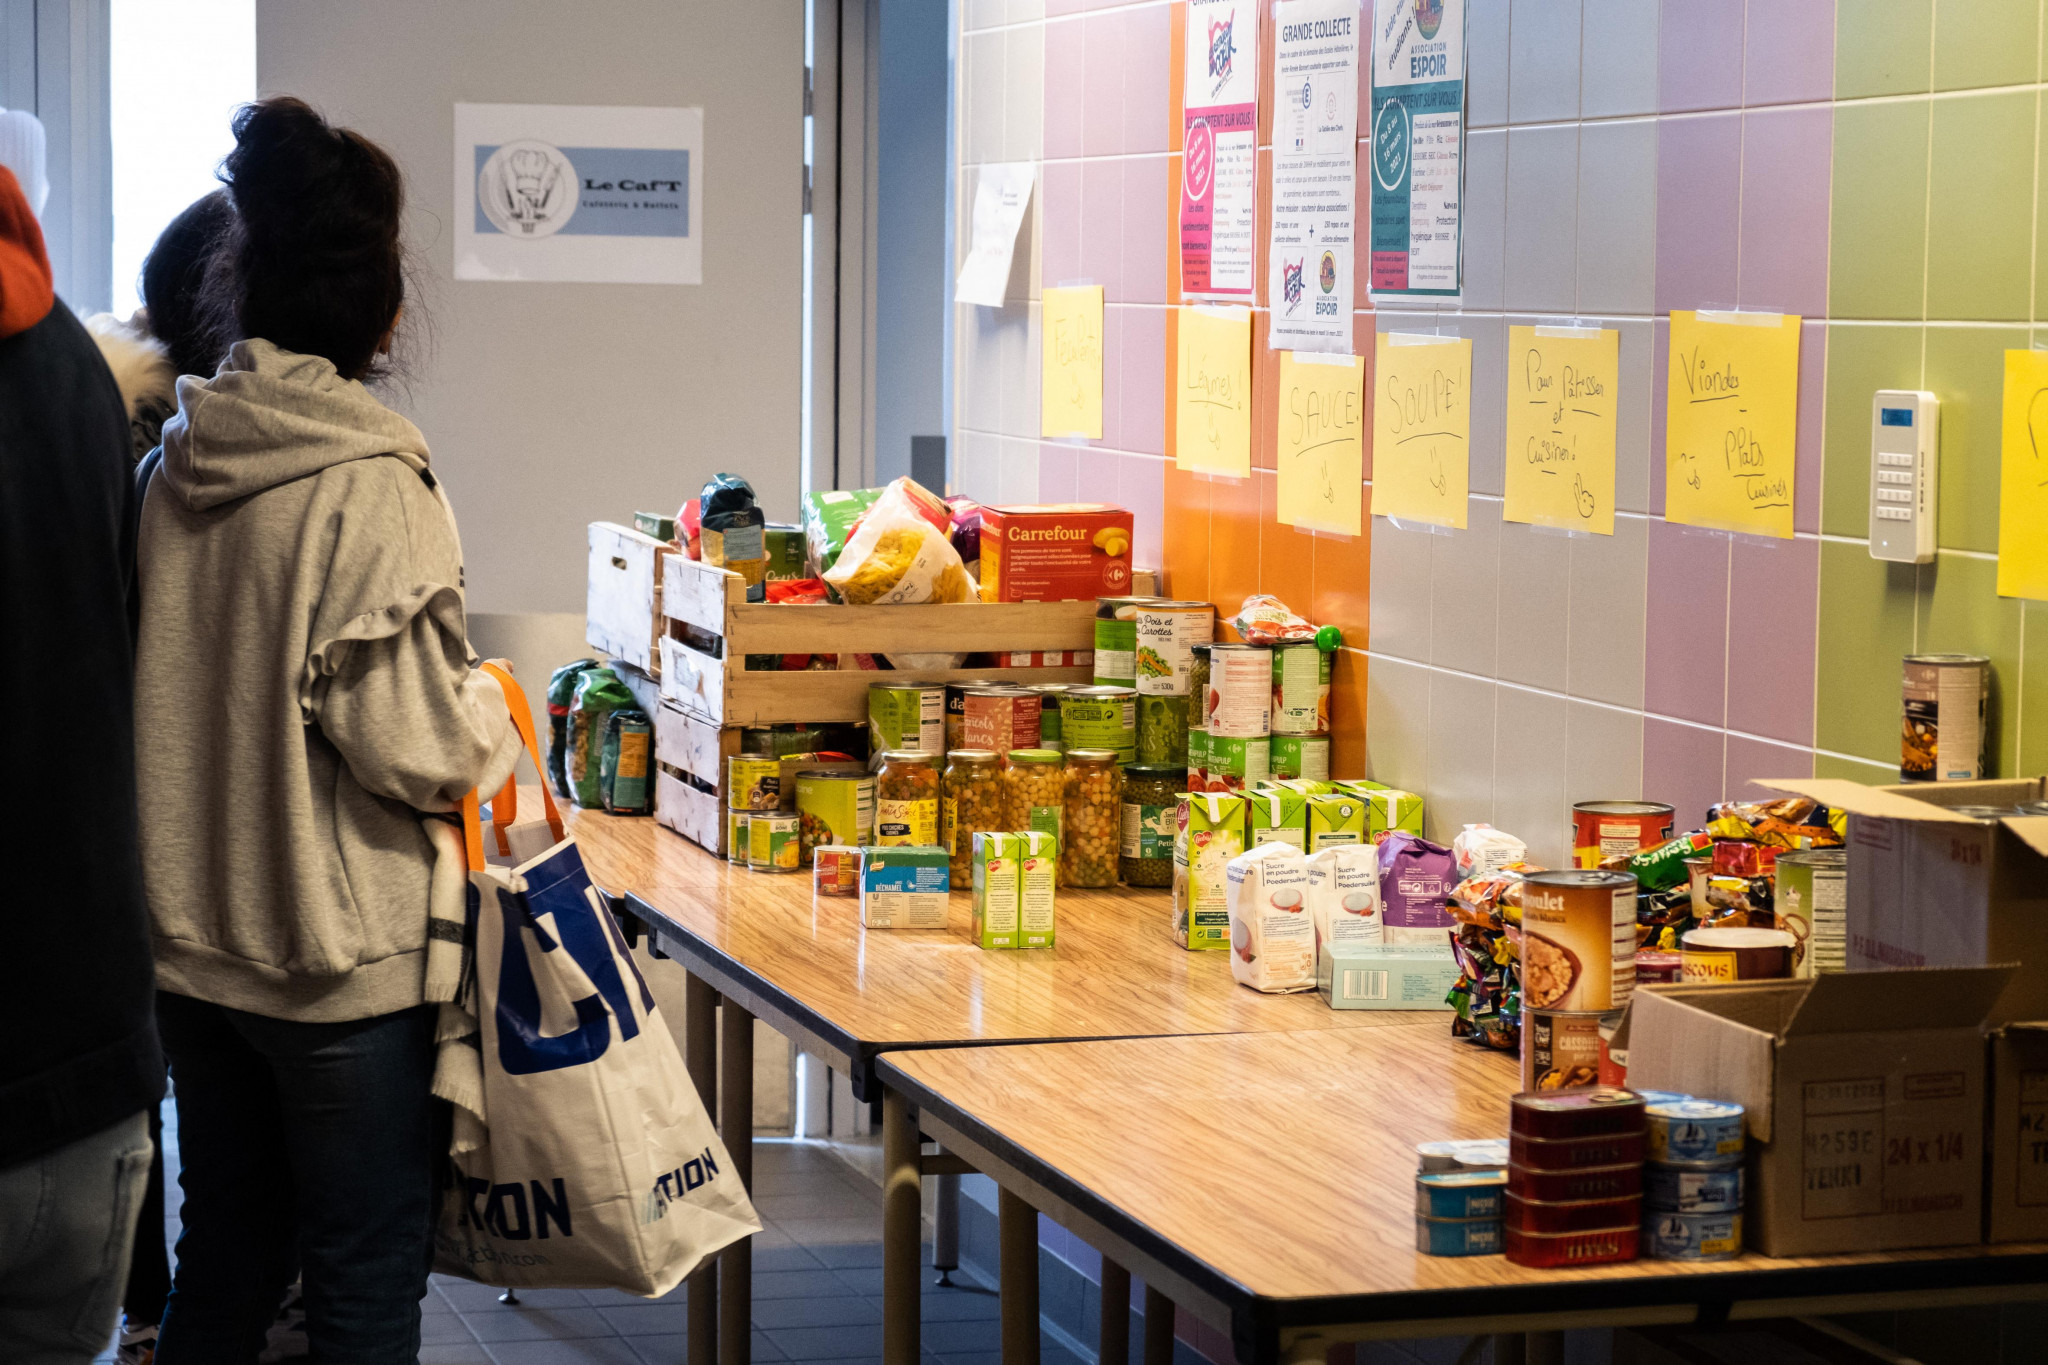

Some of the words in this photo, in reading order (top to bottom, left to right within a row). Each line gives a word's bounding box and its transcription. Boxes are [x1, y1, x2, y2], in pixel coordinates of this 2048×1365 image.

[1282, 22, 1313, 43] GRANDE
[1314, 16, 1351, 39] COLLECTE
[1385, 14, 1396, 42] Aide
[1388, 16, 1412, 70] étudiants
[1411, 42, 1447, 54] ASSOCIATION
[1410, 54, 1446, 78] ESPOIR
[1385, 92, 1423, 110] COMPTENT
[1424, 92, 1437, 108] SUR
[1439, 90, 1457, 106] VOUS
[1224, 113, 1234, 127] SUR
[1236, 112, 1251, 126] VOUS
[1390, 131, 1401, 152] mars
[1389, 152, 1401, 174] 2021
[584, 178, 614, 191] Le
[1316, 302, 1338, 316] ESPOIR
[1187, 344, 1233, 408] Légumes
[1526, 348, 1554, 393] Pour
[1680, 346, 1740, 396] Viandes
[1552, 402, 1564, 424] et
[1725, 426, 1764, 471] Plats
[1008, 525, 1087, 541] Carrefour
[1141, 625, 1173, 636] Carottes
[1144, 615, 1162, 626] Pois
[1164, 616, 1173, 626] et
[1266, 876, 1307, 885] Poedersuiker
[1275, 868, 1299, 876] poudre
[875, 882, 902, 892] BÉCHAMEL
[1887, 1138, 1912, 1166] 24
[1918, 1140, 1930, 1164] x
[1566, 1242, 1620, 1258] TITUS
